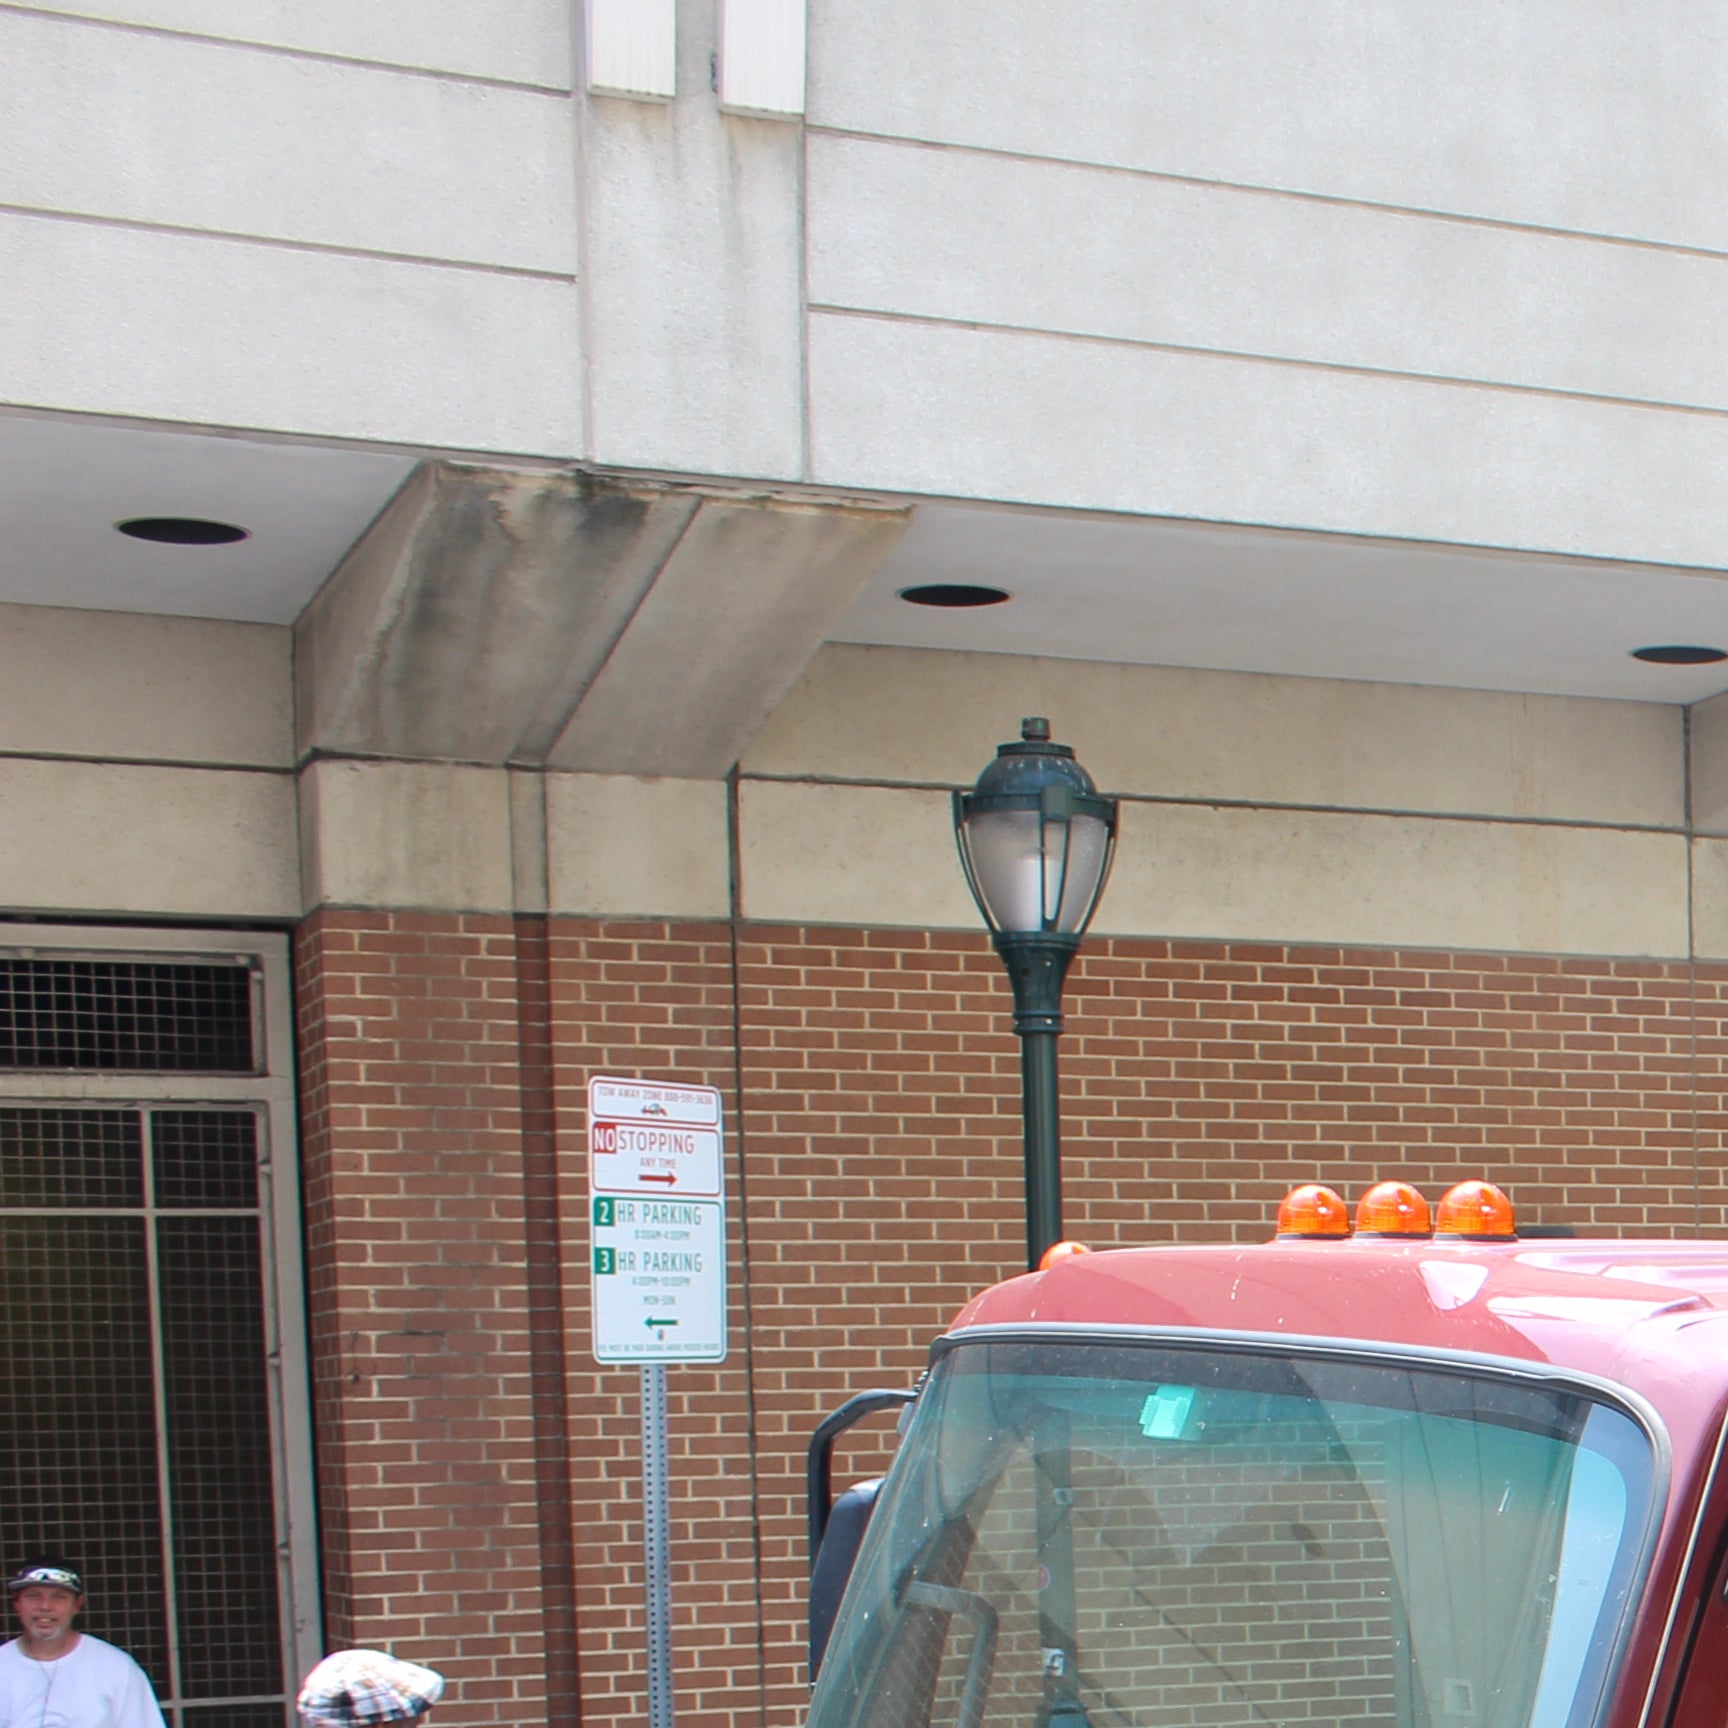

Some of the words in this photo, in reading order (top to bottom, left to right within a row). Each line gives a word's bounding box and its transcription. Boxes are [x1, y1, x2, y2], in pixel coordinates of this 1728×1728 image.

[594, 1127, 616, 1151] NO
[618, 1130, 695, 1154] STOPPING
[640, 1158, 656, 1167] ANY
[659, 1159, 677, 1169] TIME
[599, 1201, 609, 1223] 2
[617, 1203, 635, 1222] HR
[642, 1204, 702, 1225] PARKING
[600, 1250, 610, 1272] 3
[618, 1251, 636, 1271] HR
[643, 1252, 702, 1273] PARKING
